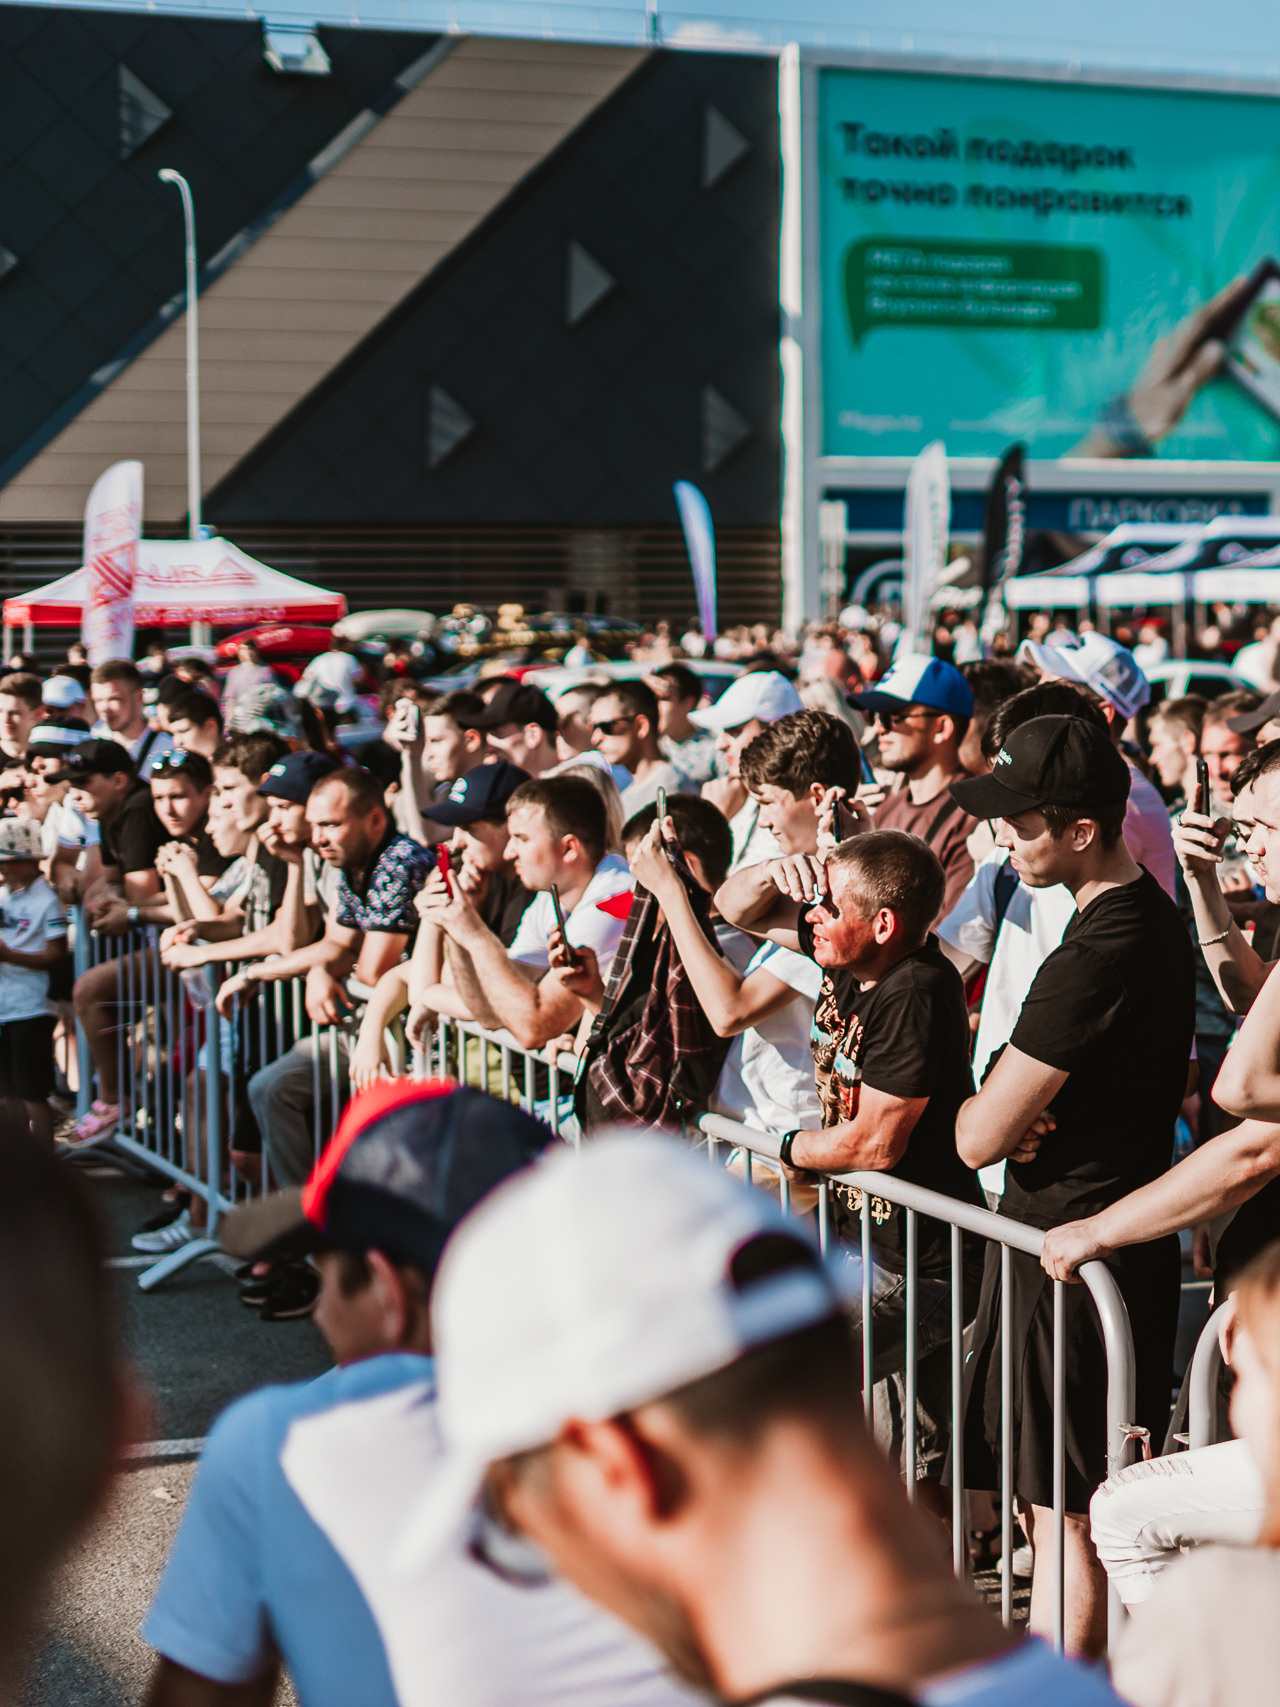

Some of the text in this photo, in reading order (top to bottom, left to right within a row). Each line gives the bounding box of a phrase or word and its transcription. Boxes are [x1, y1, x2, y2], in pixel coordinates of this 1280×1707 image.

[839, 121, 1137, 175] Такой подарок
[838, 177, 1194, 223] точно понравится
[1068, 497, 1248, 530] ПАРКОВКА
